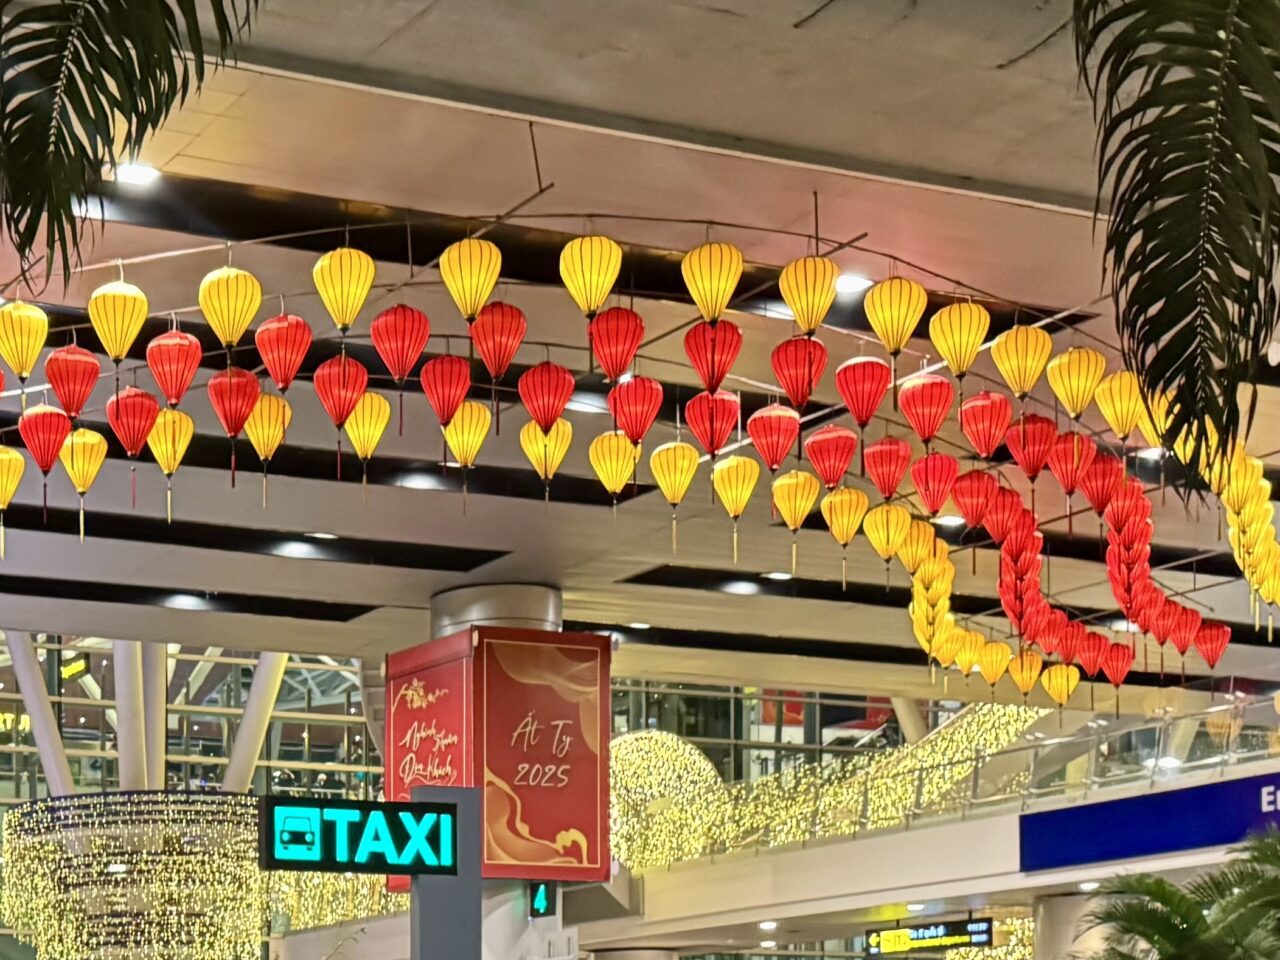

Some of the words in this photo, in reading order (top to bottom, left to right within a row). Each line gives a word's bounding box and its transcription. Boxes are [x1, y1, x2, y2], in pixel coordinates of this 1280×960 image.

[513, 762, 572, 788] 2025
[324, 808, 453, 867] TAXI
[533, 883, 548, 914] 4
